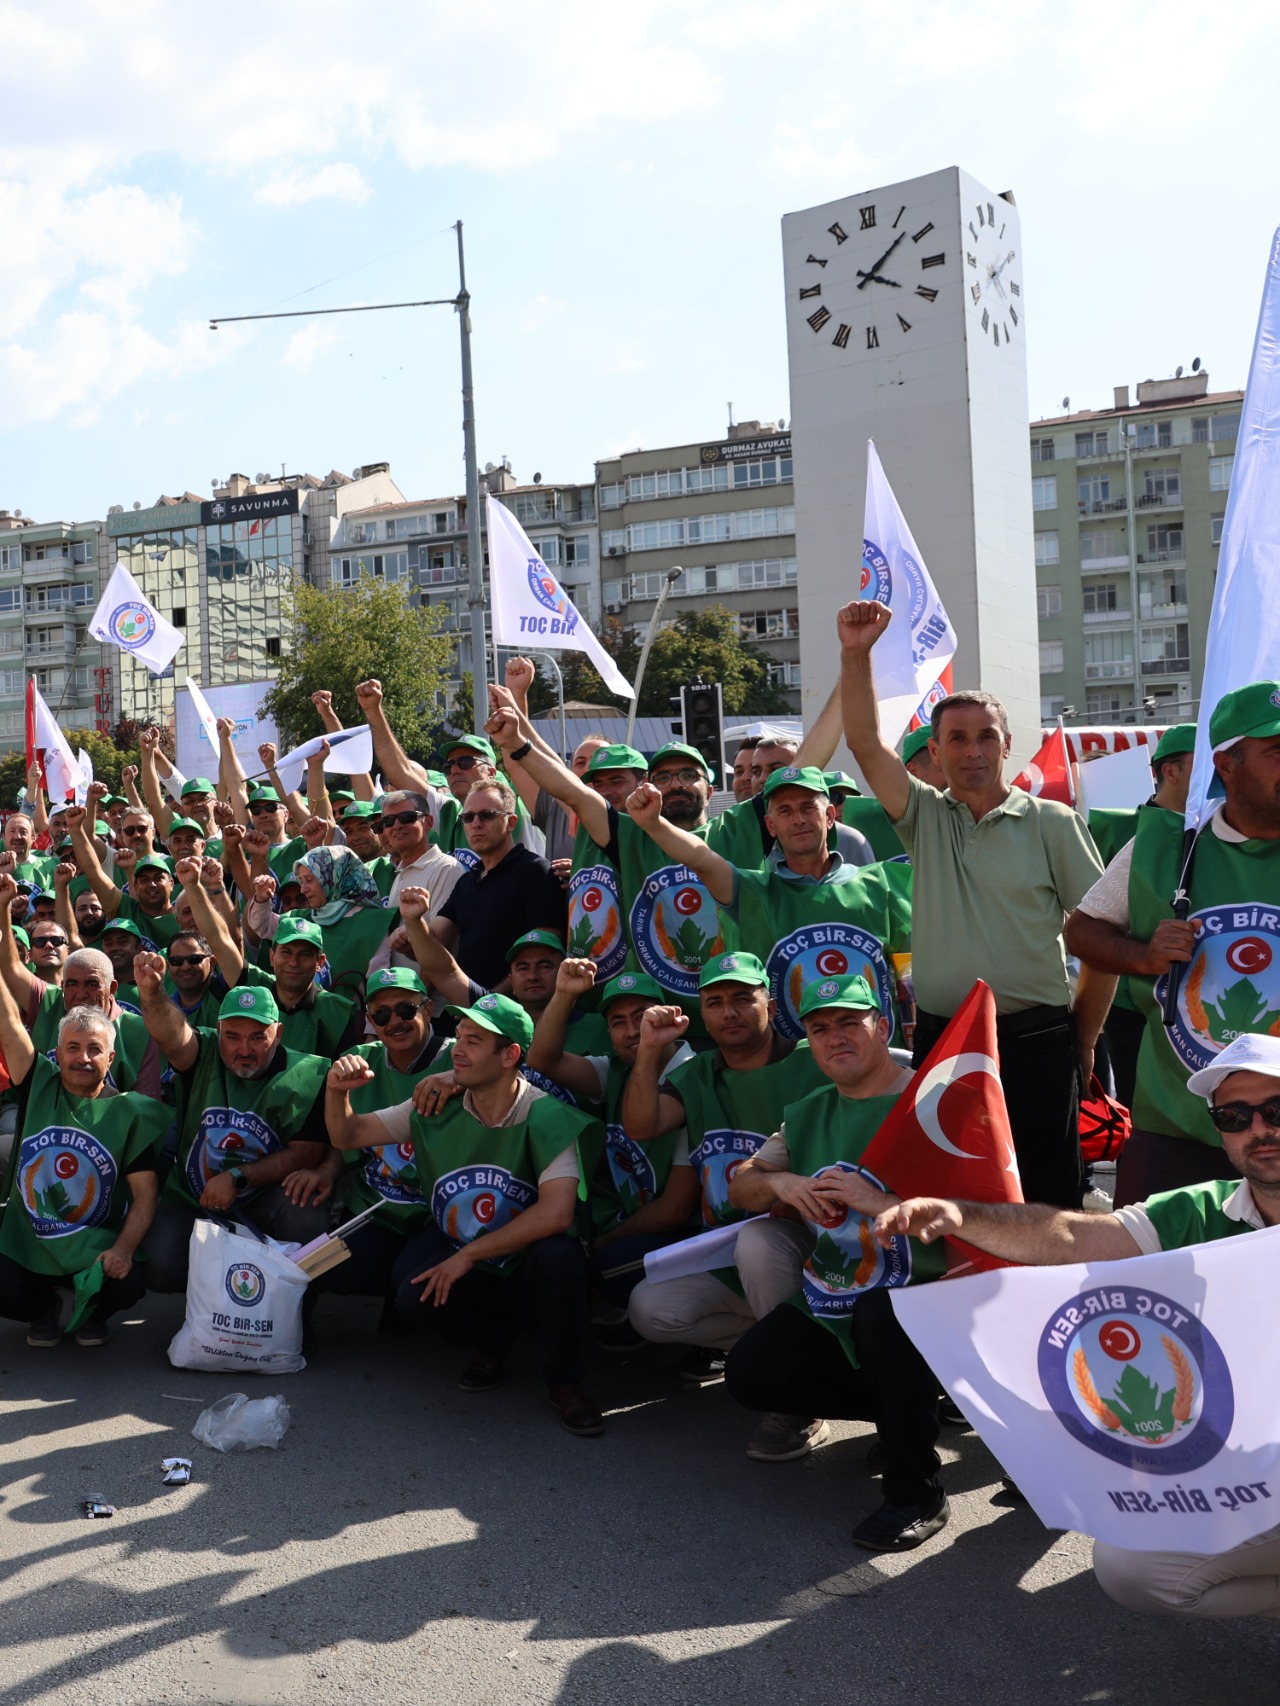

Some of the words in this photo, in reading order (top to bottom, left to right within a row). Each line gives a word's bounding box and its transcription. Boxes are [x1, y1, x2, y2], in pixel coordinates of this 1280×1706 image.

[722, 443, 756, 454] DURMAZ
[231, 498, 290, 513] SAVUNMA
[872, 556, 889, 603] BİR-SE
[520, 616, 547, 634] TOÇ
[646, 874, 669, 899] TOÇ
[636, 908, 647, 933] TARIM
[638, 940, 658, 970] ORMAN
[778, 935, 809, 961] TOÇ
[813, 927, 883, 964] BİR-SEN
[657, 969, 699, 989] ÇALIŞAN
[1171, 1025, 1186, 1050] MAN
[229, 1113, 271, 1145] İR-SEN
[61, 1131, 112, 1176] BİR-SEN
[437, 1175, 470, 1199] TOÇ
[885, 1235, 897, 1287] SENDİKAS
[825, 1271, 845, 1284] 2001
[233, 1316, 273, 1332] BİR-SEN
